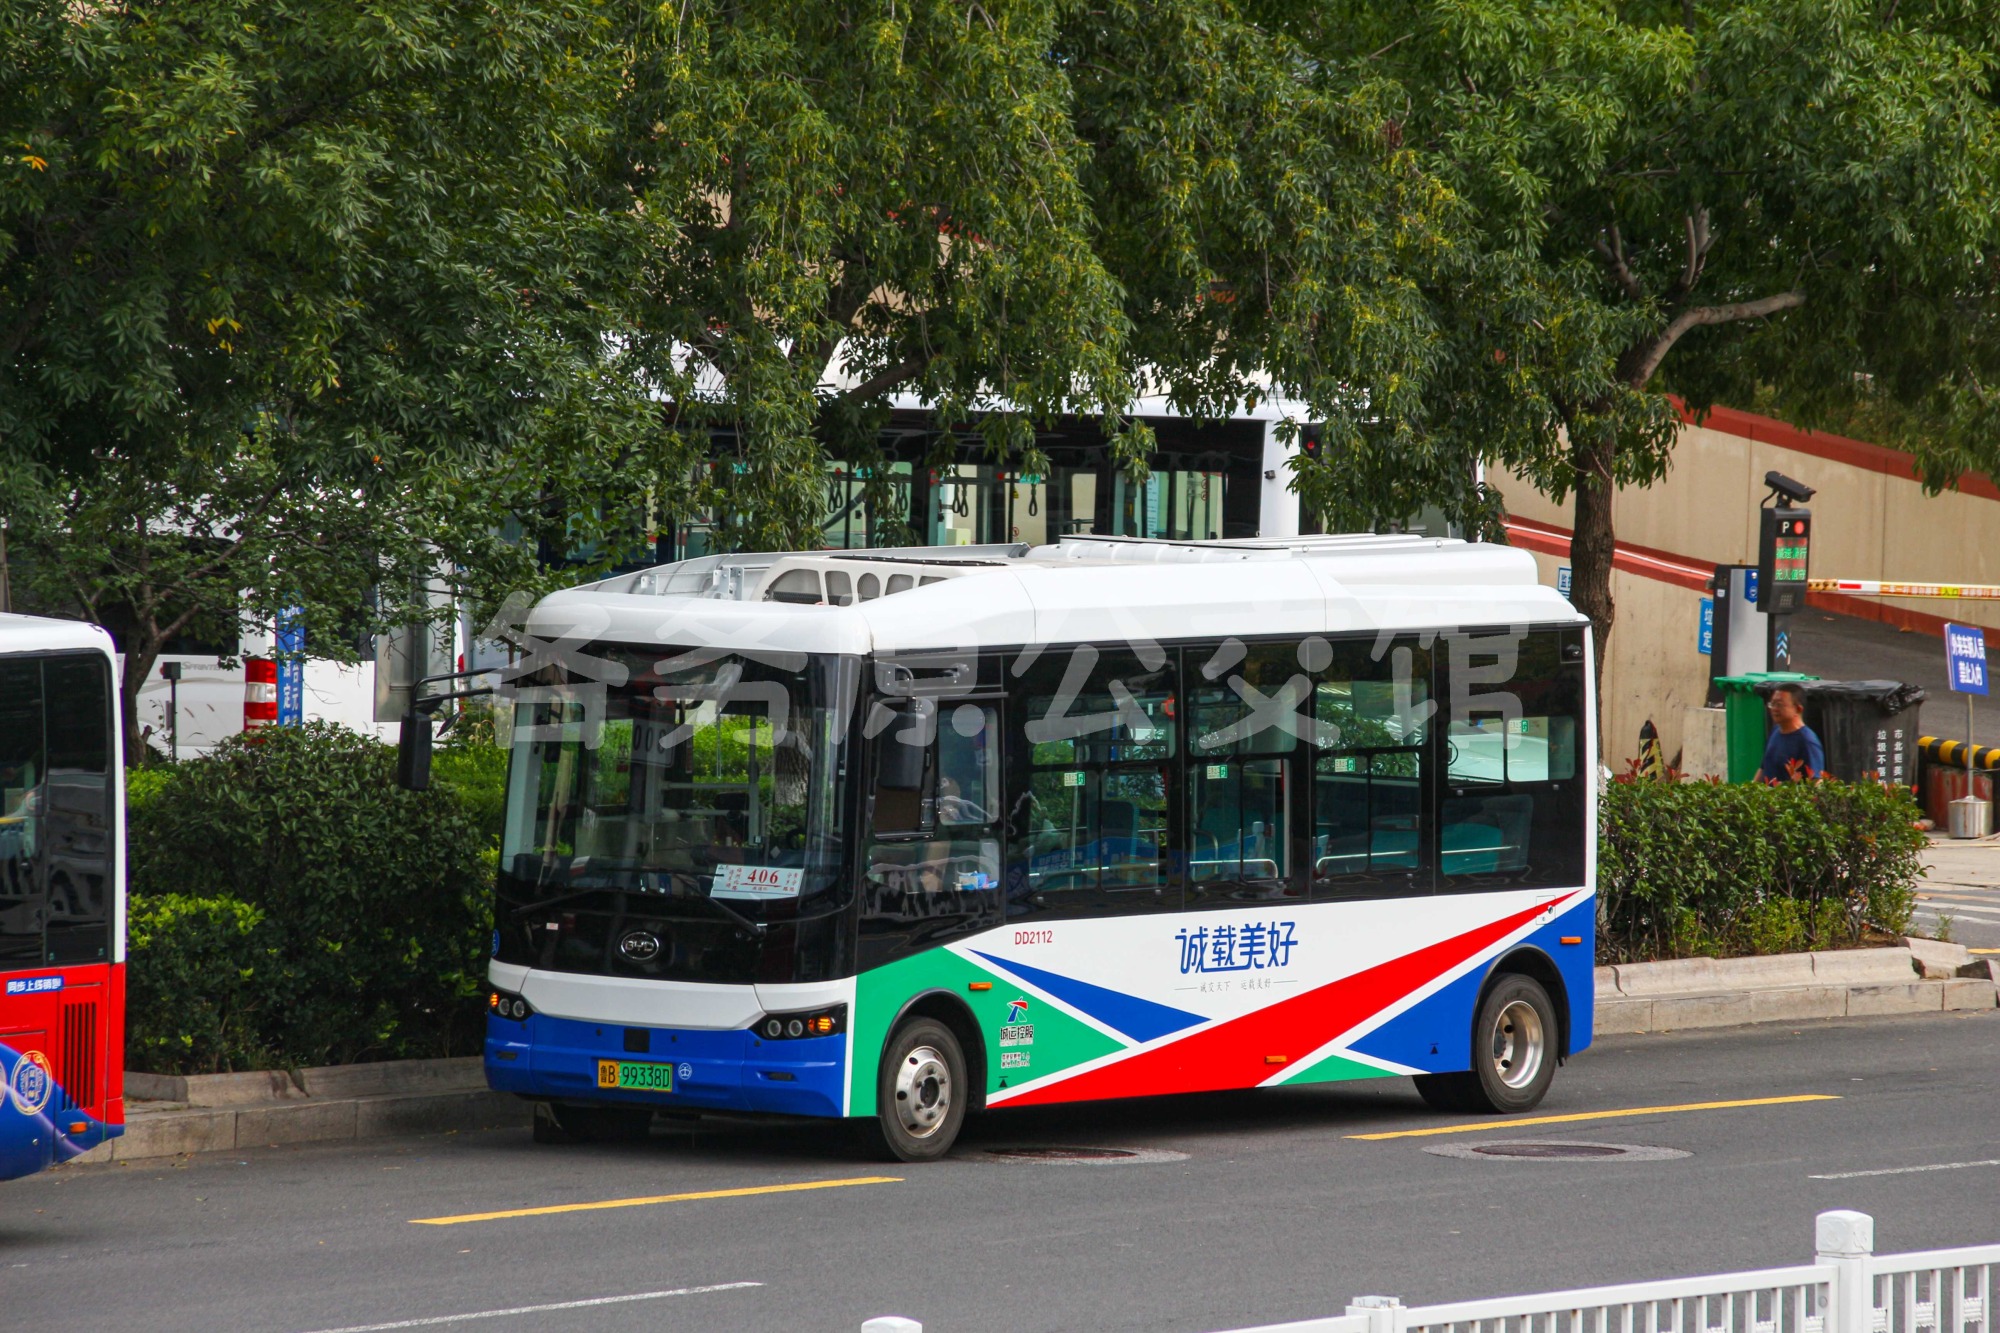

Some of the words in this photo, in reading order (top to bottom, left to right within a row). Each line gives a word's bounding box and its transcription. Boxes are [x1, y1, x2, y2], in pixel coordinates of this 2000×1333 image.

[1782, 521, 1790, 534] P
[1959, 661, 1983, 686] 禁止入内
[747, 868, 780, 885] 406
[625, 940, 655, 952] BYD
[1015, 930, 1053, 945] DD2112
[1174, 921, 1298, 974] 诚载美好
[1000, 1024, 1034, 1041] 城运控股
